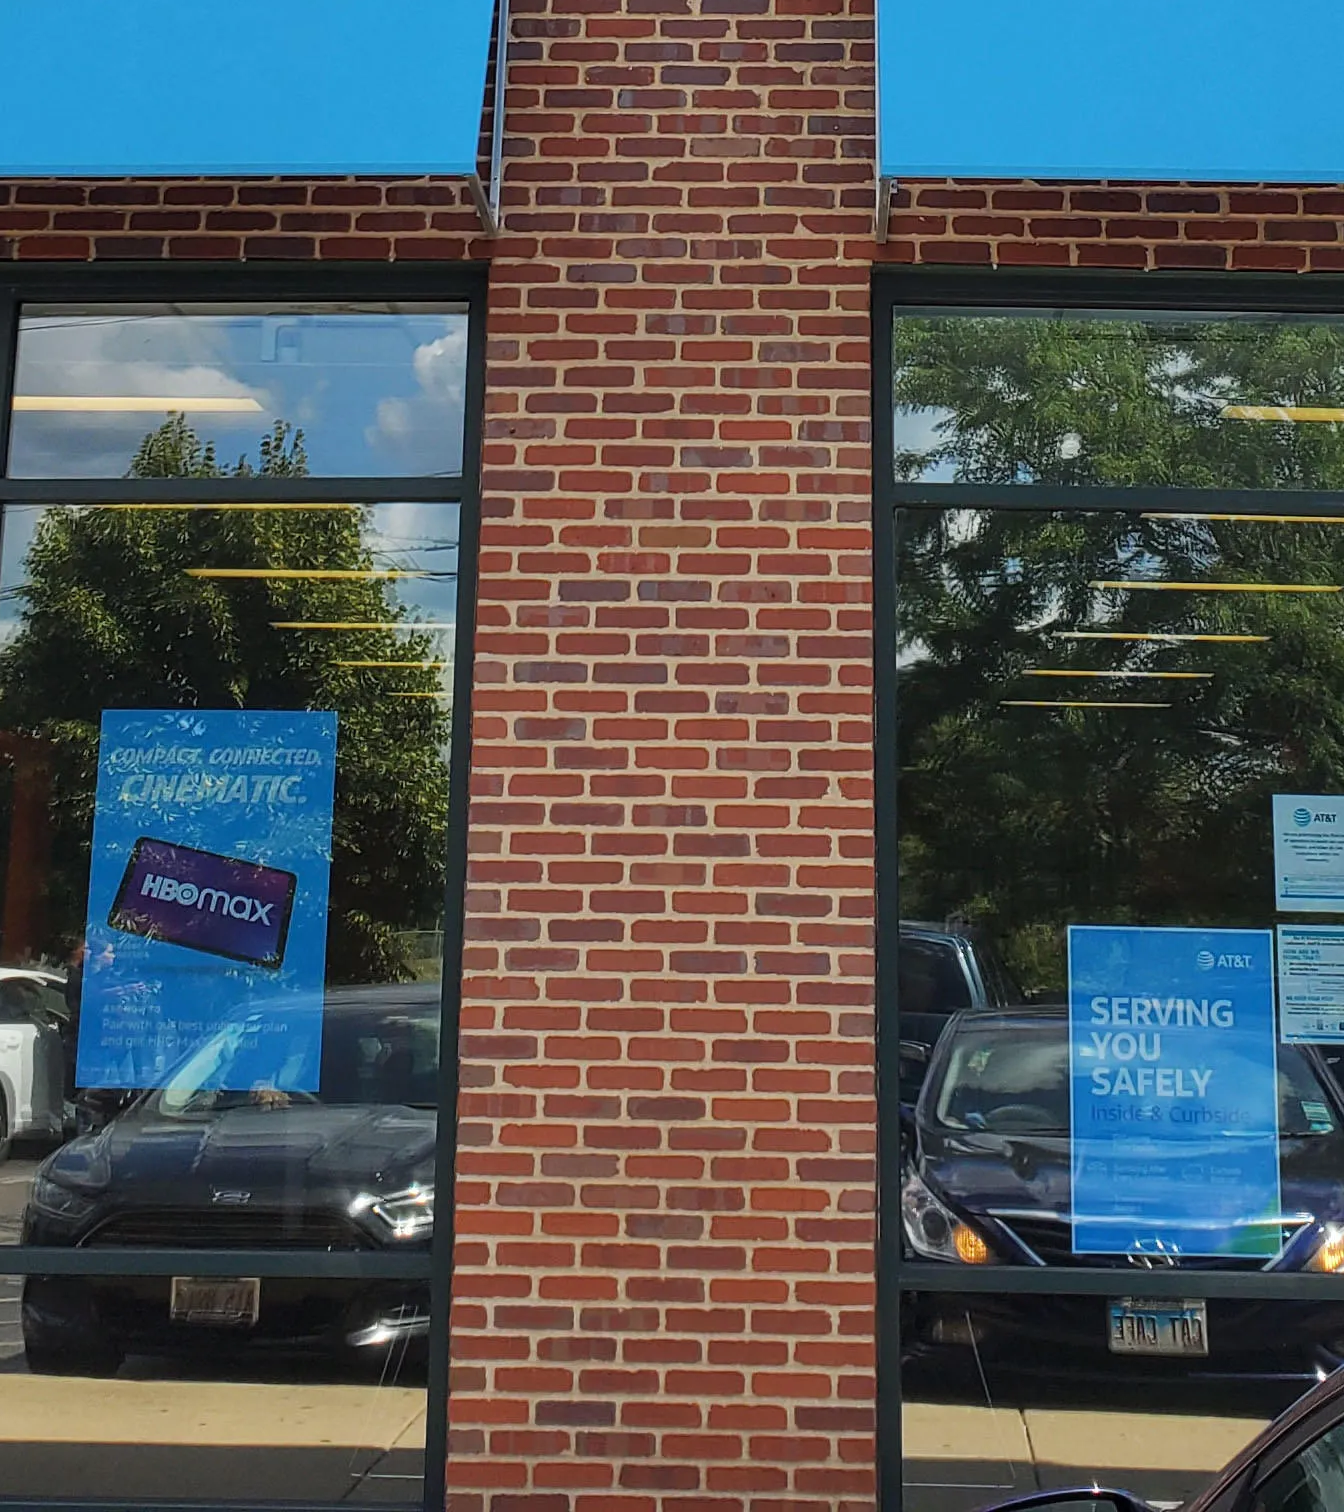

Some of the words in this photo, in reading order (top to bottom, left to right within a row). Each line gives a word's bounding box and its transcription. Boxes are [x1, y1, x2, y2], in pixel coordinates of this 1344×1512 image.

[209, 747, 323, 766] CONNECTED.
[119, 774, 308, 804] CINEMATIC.
[1313, 813, 1337, 823] AT&T
[1217, 955, 1252, 969] AT&T
[1091, 996, 1235, 1028] SERVING
[1090, 1031, 1162, 1061] YOU
[1091, 1067, 1214, 1098] SAFELY
[1091, 1105, 1143, 1122] Inside
[1150, 1106, 1163, 1122] &
[1169, 1106, 1253, 1125] Curbside
